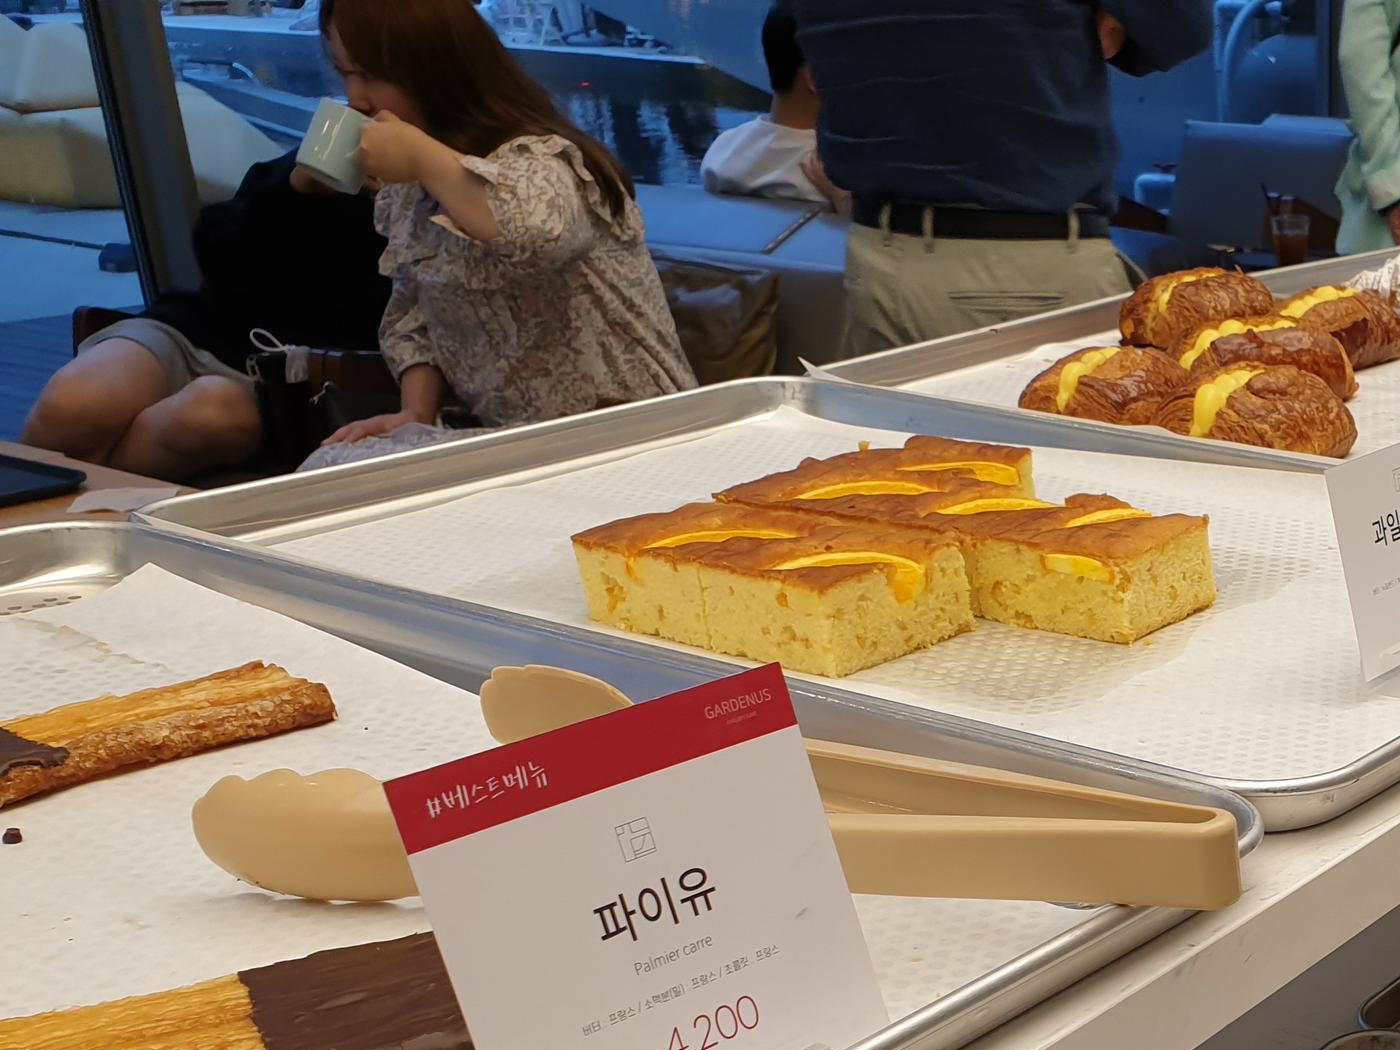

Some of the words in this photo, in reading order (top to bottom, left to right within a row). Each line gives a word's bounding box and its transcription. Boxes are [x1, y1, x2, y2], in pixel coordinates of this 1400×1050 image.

[704, 688, 772, 720] GARDENUS
[426, 761, 548, 818] #베스트메뉴
[593, 868, 716, 941] 파이유
[633, 948, 680, 976] Palmier
[682, 935, 713, 956] carre
[608, 1006, 637, 1026] 프랑스
[691, 971, 718, 990] 프랑스
[755, 943, 780, 962] 프랑스
